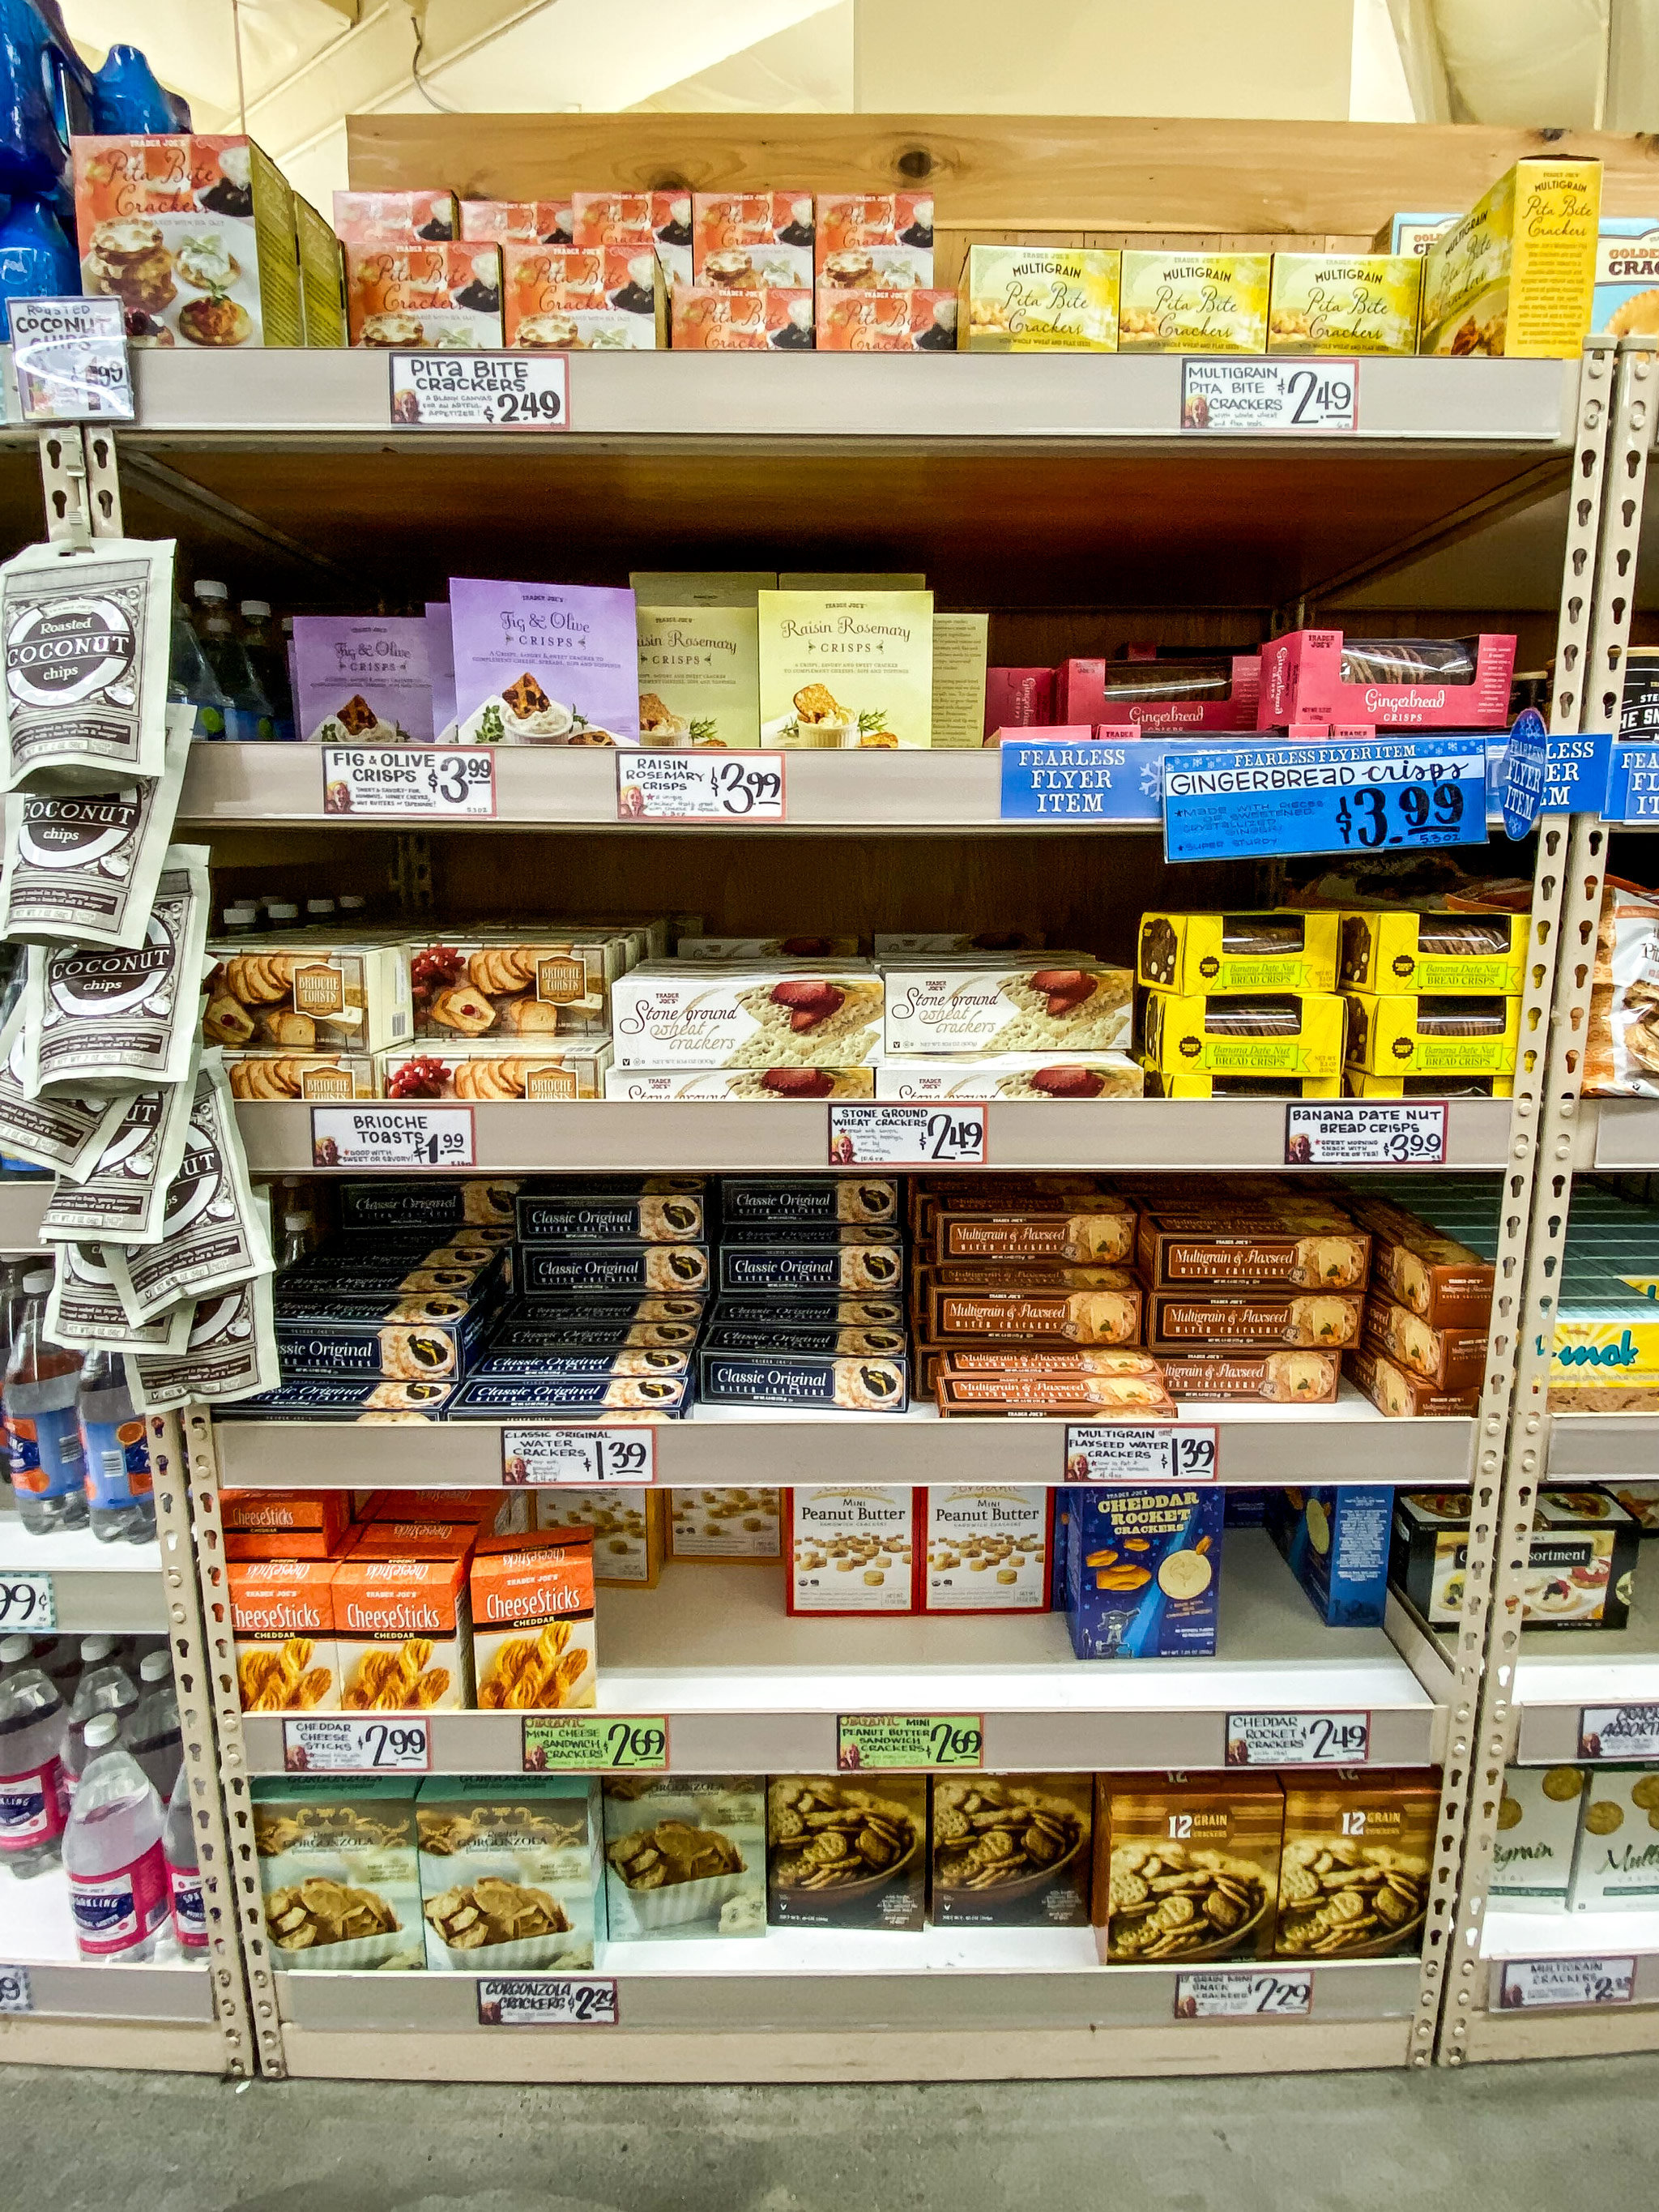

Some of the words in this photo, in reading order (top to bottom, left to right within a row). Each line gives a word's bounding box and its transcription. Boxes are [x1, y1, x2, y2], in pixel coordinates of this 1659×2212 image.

[104, 148, 152, 188] Pita
[161, 148, 213, 184] Bite
[1013, 263, 1081, 279] MULTIGRAIN
[1004, 281, 1041, 309] Pita
[1046, 281, 1089, 309] Bite
[16, 318, 111, 334] COCONUT
[1009, 309, 1083, 335] Crackers
[474, 361, 528, 378] BITE
[1189, 367, 1277, 378] MULTIGRAIN
[1190, 382, 1222, 394] PITA
[1232, 382, 1265, 393] BITE
[484, 391, 561, 423] $2.49
[1209, 399, 1283, 411] CRACKERS
[41, 618, 92, 635] Roasted
[501, 611, 525, 632] Fig
[529, 613, 547, 630] &
[550, 612, 590, 633] Olive
[781, 620, 832, 638] Raisin
[838, 617, 911, 643] Rosemary
[519, 635, 573, 647] CRISPS
[821, 643, 871, 652] CRISPS
[7, 635, 129, 667] COCONUT
[43, 665, 79, 682] chips
[1364, 689, 1445, 713] Gingerbread
[1384, 713, 1422, 722] CRISPS
[1019, 749, 1125, 767] FEARLESS
[1235, 750, 1316, 768] FEARLESS
[1319, 748, 1372, 763] FLYER
[1375, 745, 1416, 758] ITEM
[1510, 739, 1545, 764] FEARLESS
[334, 753, 364, 766] FIG
[369, 756, 377, 765] &
[381, 754, 435, 767] OLIVE
[638, 758, 688, 770] RAISIN
[352, 770, 416, 782] CRISPS
[428, 757, 492, 803] $3.99
[626, 770, 705, 782] ROSEMARY
[1030, 770, 1112, 789] FLYER
[1362, 760, 1469, 788] crisps
[1506, 758, 1540, 793] FLYER
[642, 782, 687, 791] CRISPS
[1037, 793, 1104, 813] ITEM
[1504, 785, 1534, 821] ITEM
[1336, 783, 1465, 848] $3.99
[298, 976, 340, 992] BRIOCHE
[300, 990, 336, 1004] TOASTS
[620, 1000, 677, 1035] Stone
[680, 996, 753, 1025] ground
[650, 1021, 706, 1040] wheat
[669, 1025, 736, 1050] crackers
[1213, 1045, 1247, 1053] Banana
[1250, 1046, 1271, 1054] Date
[1215, 1057, 1248, 1065] BREAD
[1251, 1057, 1286, 1065] CRISPS
[842, 1109, 878, 1118] STONE
[882, 1109, 928, 1118] GROUND
[1406, 1111, 1441, 1121] NUT
[353, 1116, 429, 1129] BRIOCHE
[1370, 1124, 1420, 1133] CRISPS
[1384, 1134, 1441, 1162] $3.99
[736, 1261, 778, 1274] Classic
[780, 1261, 833, 1279] Original
[949, 1303, 1004, 1320] Multigrain
[1017, 1303, 1065, 1318] Flaxseed
[718, 1368, 765, 1384] Classic
[768, 1370, 827, 1395] Original
[1078, 1430, 1154, 1438] MULTIGRAIN
[514, 1449, 586, 1457] CRACKERS
[1069, 1440, 1124, 1449] FLAXSEED
[1129, 1441, 1169, 1450] WATER
[1098, 1492, 1199, 1513] CHEDDAR
[801, 1508, 854, 1520] Peanut
[858, 1508, 906, 1520] Butter
[1111, 1509, 1191, 1526] ROCKET
[1115, 1524, 1184, 1535] CRACKERS
[347, 1603, 440, 1629] CheeseSticks
[296, 1723, 351, 1732] CHEDDAR
[1233, 1717, 1298, 1727] CHEDDAR
[301, 1733, 348, 1741] CHEESE
[527, 1730, 552, 1738] MINI
[558, 1729, 599, 1737] CHEESE
[1246, 1729, 1296, 1740] ROCKET
[307, 1742, 352, 1751] STICKS
[542, 1740, 599, 1749] SANDWICH
[1247, 1740, 1303, 1749] CRACKERS
[546, 1750, 603, 1758] CRACKERS
[1168, 1815, 1192, 1838] 12
[1193, 1815, 1227, 1826] GRAIN
